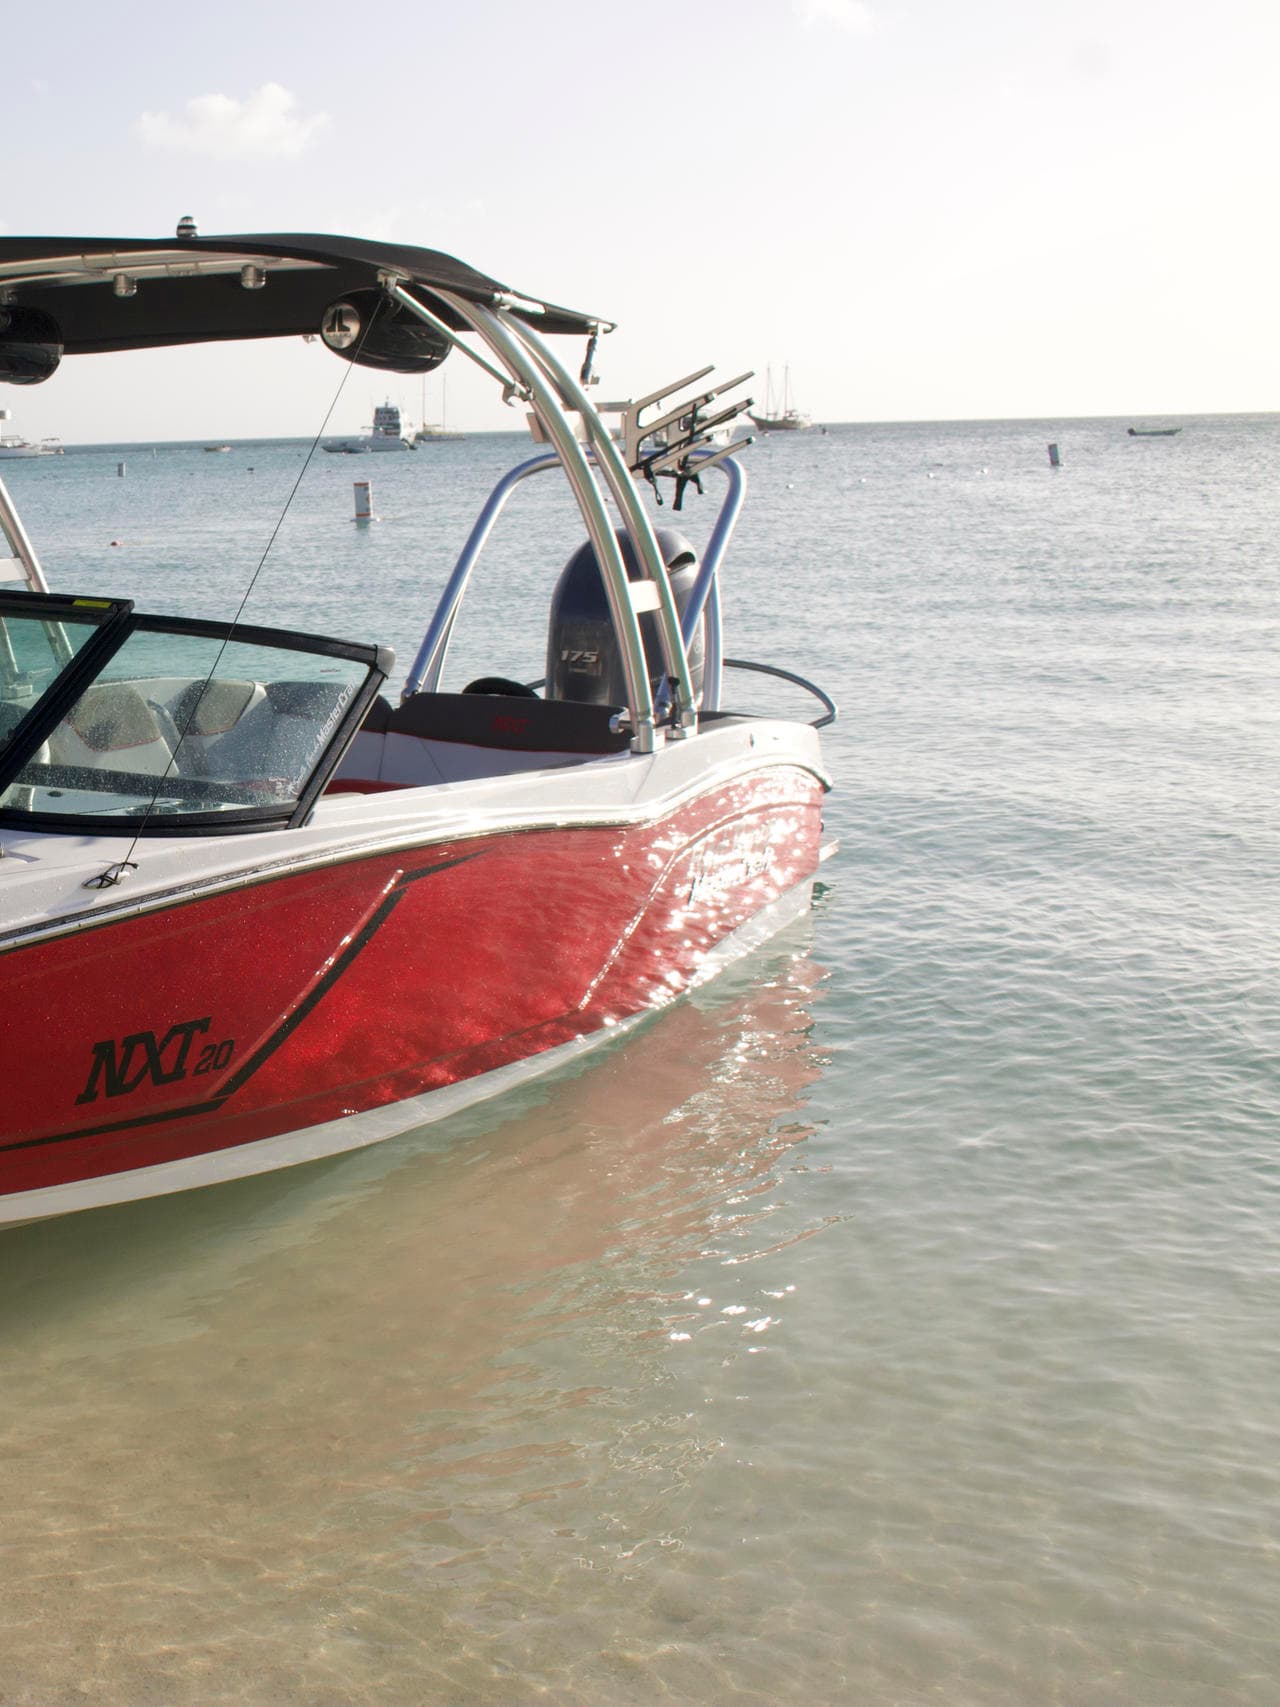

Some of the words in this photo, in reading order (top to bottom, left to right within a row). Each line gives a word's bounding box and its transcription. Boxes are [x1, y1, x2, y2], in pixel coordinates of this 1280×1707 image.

[561, 649, 599, 663] 175
[74, 1016, 213, 1106] NXT
[192, 1039, 235, 1077] 20
